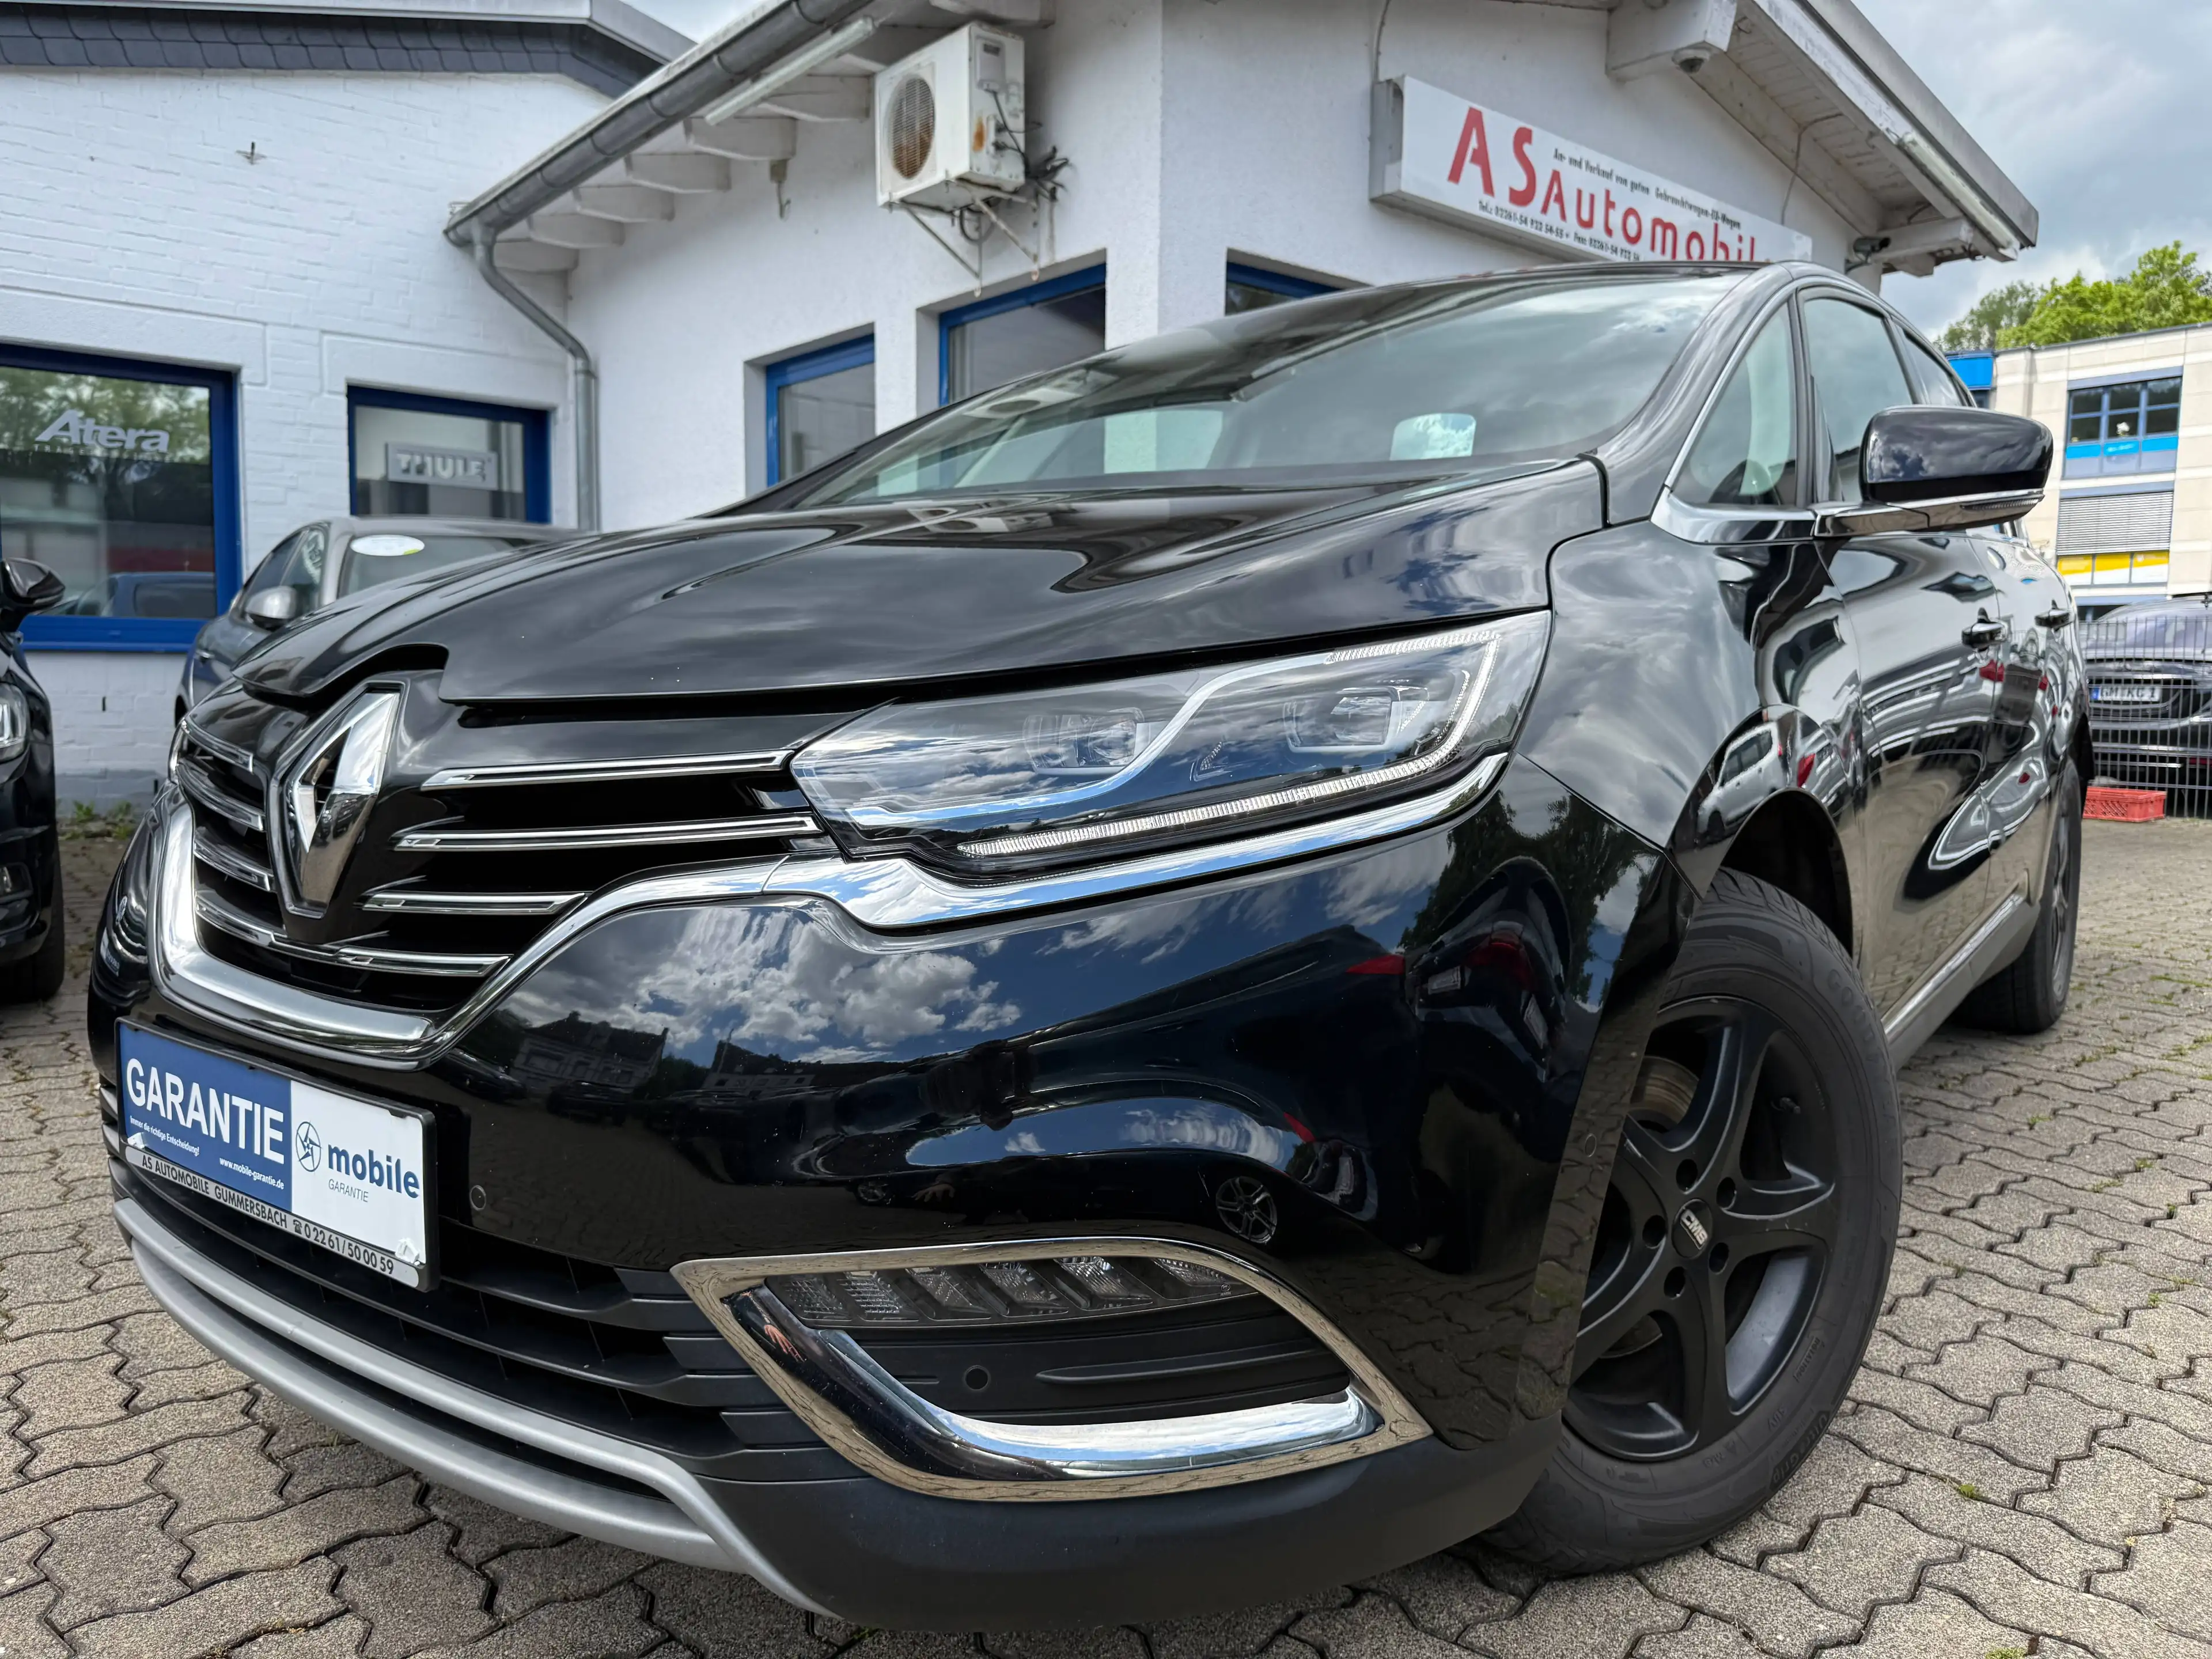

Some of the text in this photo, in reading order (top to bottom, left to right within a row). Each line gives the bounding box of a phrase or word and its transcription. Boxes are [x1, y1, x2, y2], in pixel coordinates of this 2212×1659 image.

[1569, 156, 1583, 169] und
[1540, 169, 1769, 262] Automobil
[35, 409, 170, 453] Atera
[396, 451, 486, 482] THULE
[127, 1058, 285, 1165] GARANTIE
[130, 1115, 143, 1129] Immer
[150, 1126, 166, 1141] richtige
[166, 1132, 200, 1157] Entscheidung!
[142, 1154, 153, 1170] AS
[155, 1160, 210, 1195] AUTOMOBILE
[214, 1185, 287, 1229] GUMMERSBACH
[219, 1157, 285, 1190] www.mobile-garantie.de
[328, 1144, 420, 1199] mobile
[328, 1179, 369, 1203] GARANTIE
